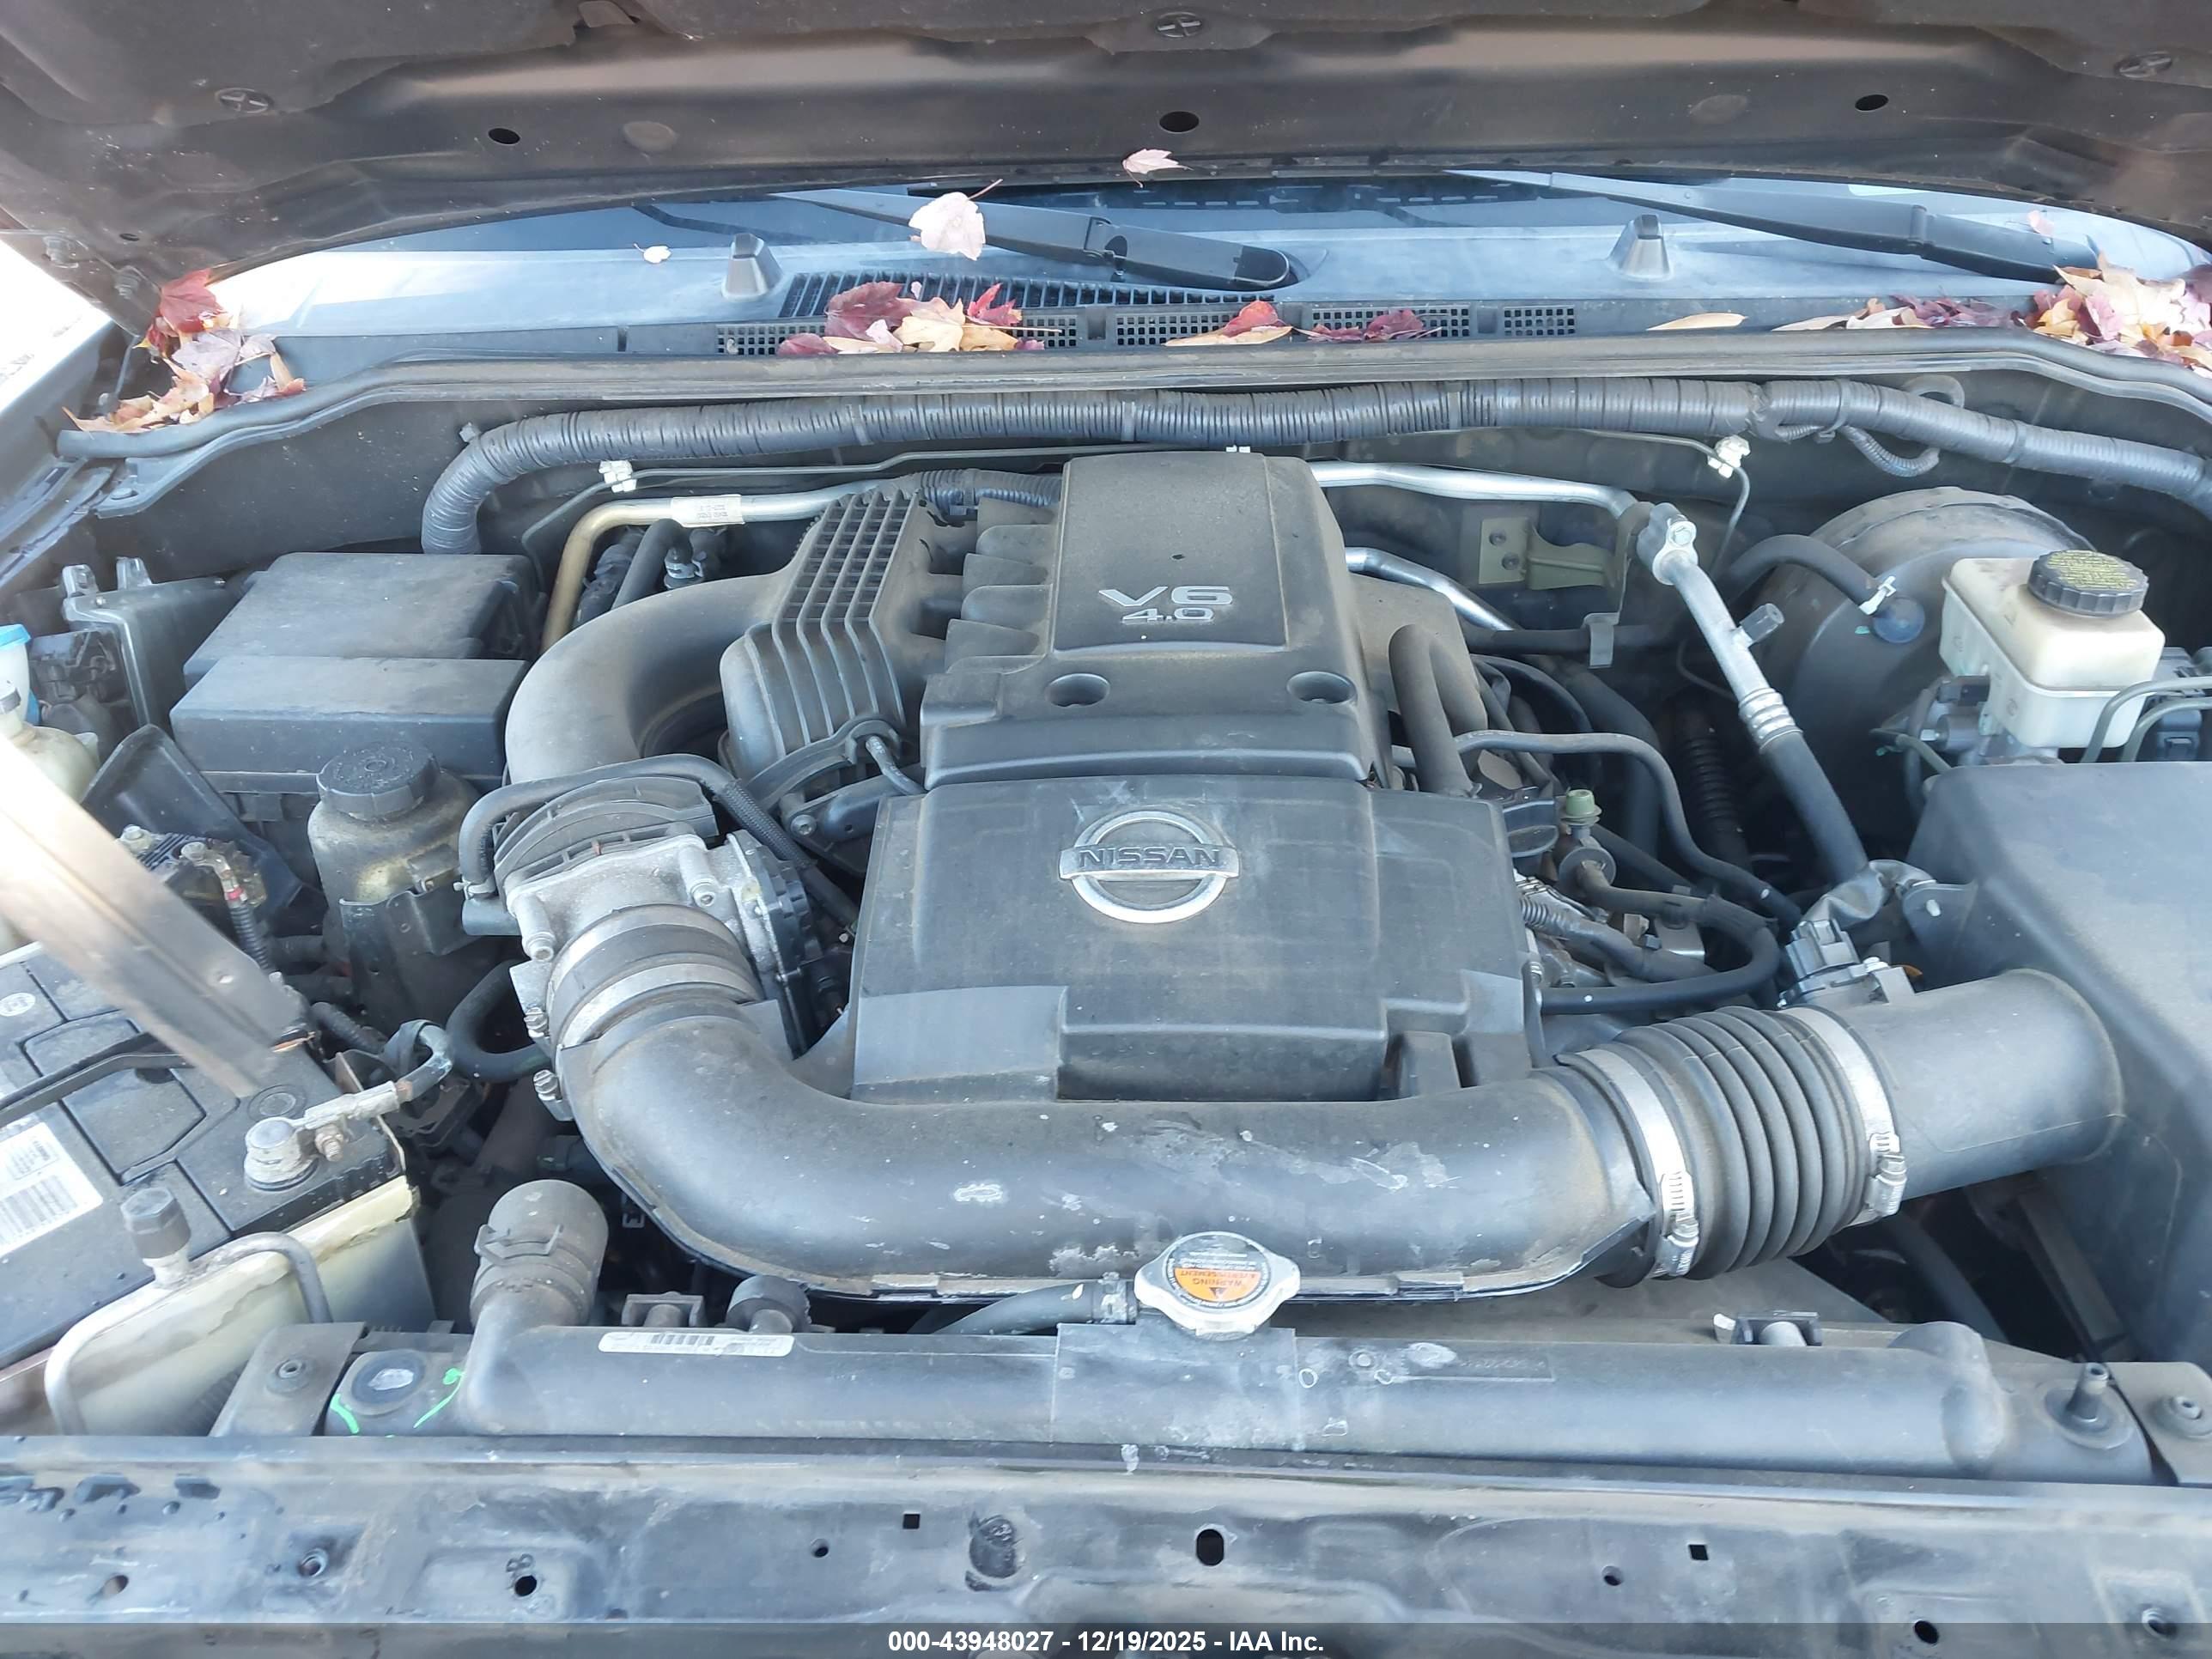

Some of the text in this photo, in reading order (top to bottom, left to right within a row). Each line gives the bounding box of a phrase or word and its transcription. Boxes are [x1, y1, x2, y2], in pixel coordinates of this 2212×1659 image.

[1099, 586, 1233, 606] V6
[1121, 608, 1214, 622] 4.0
[1079, 846, 1219, 867] NISSAN
[1192, 1278, 1243, 1286] WARNING
